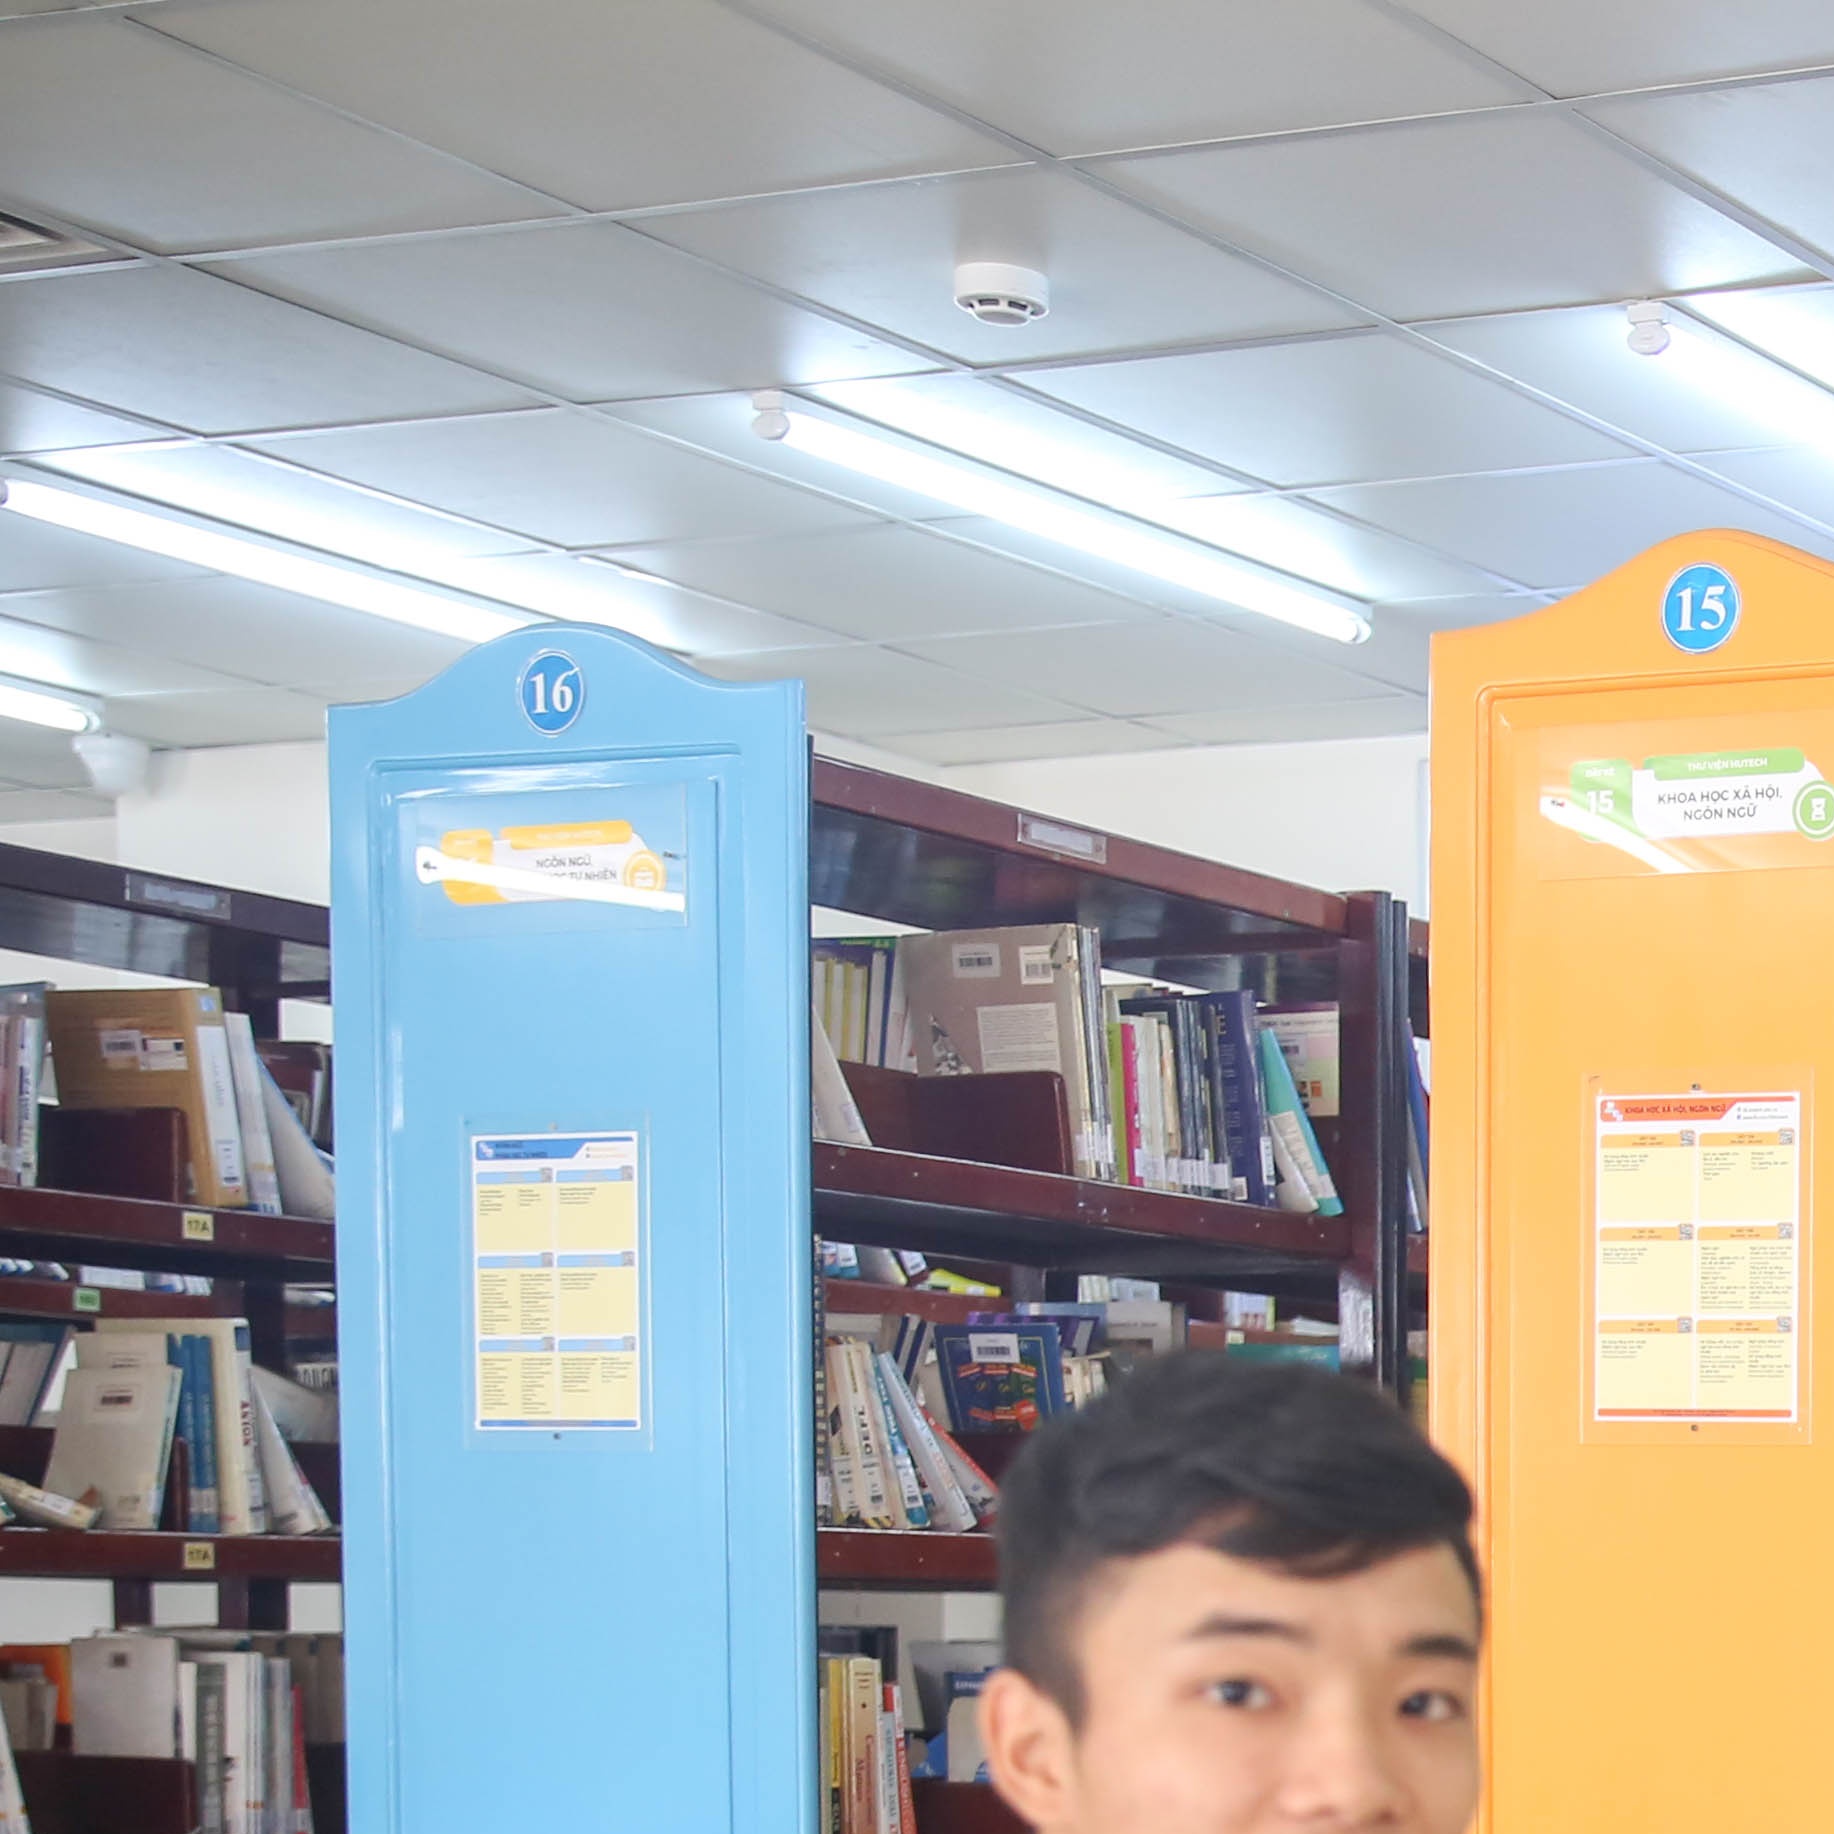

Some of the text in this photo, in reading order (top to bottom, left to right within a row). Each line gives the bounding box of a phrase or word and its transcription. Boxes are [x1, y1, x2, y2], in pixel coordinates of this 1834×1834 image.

[1675, 585, 1727, 632] 15
[529, 669, 576, 714] 16
[1728, 757, 1768, 770] HUTECH
[1586, 790, 1615, 815] 15
[1658, 792, 1697, 805] KHOA
[1700, 789, 1730, 804] HỌC
[1733, 785, 1752, 800] XÃ
[1683, 804, 1759, 821] NGÔN NGỮ
[536, 856, 566, 868] NGÔN
[584, 867, 617, 881] NHIÊN
[187, 1219, 209, 1232] 17A
